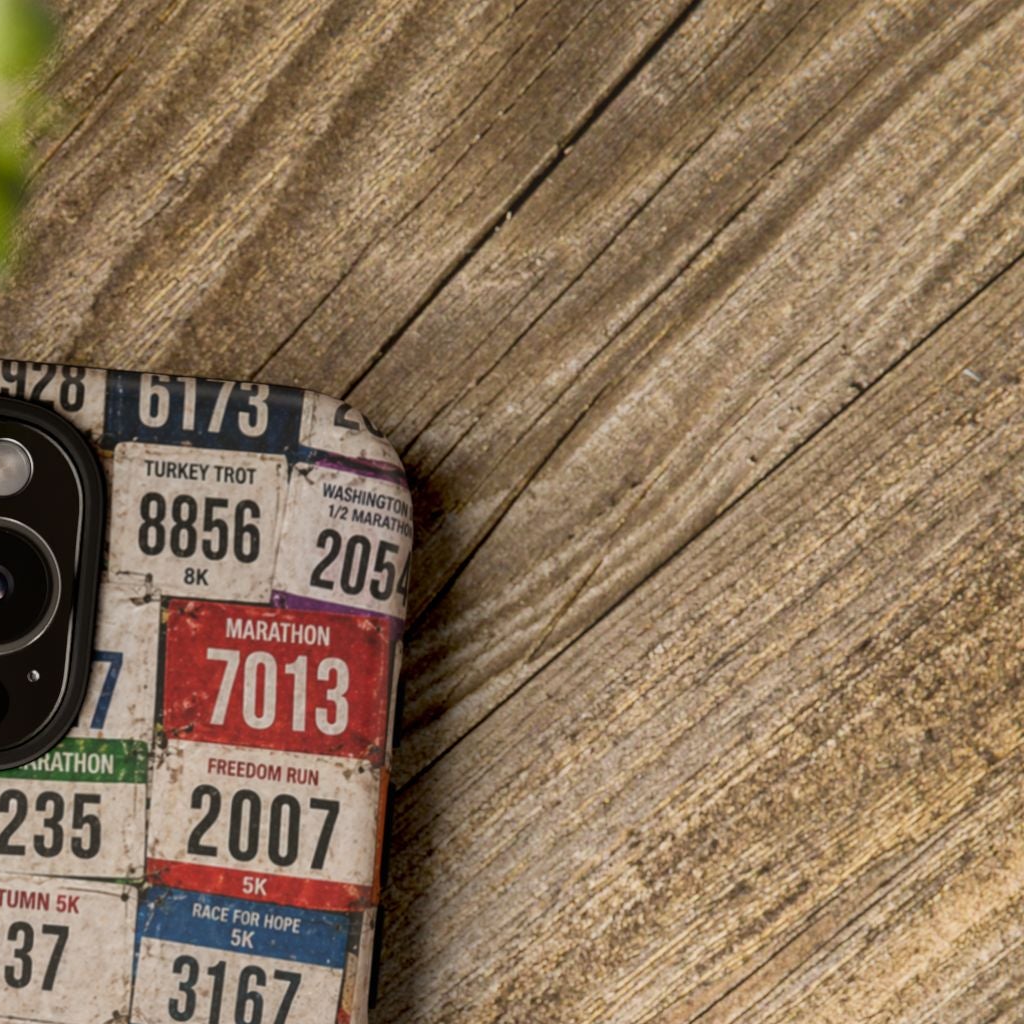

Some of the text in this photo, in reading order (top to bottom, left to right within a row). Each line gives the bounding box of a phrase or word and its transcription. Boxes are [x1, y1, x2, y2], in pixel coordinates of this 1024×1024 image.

[139, 372, 270, 437] 6173
[144, 459, 257, 485] TURKEY TROT
[322, 482, 409, 517] WASHINGTON
[328, 504, 349, 521] 1/2
[138, 491, 262, 563] 8856
[183, 567, 209, 587] 8K
[225, 617, 330, 647] MARATHON
[206, 647, 350, 736] 7013
[21, 751, 114, 775] ARATHON
[207, 757, 319, 787] FREEDOM RUN
[186, 784, 341, 871] 2007
[242, 875, 268, 896] 5K
[55, 894, 80, 914] 5K
[192, 902, 302, 934] RACE FOR HOPE
[230, 928, 255, 949] 5K
